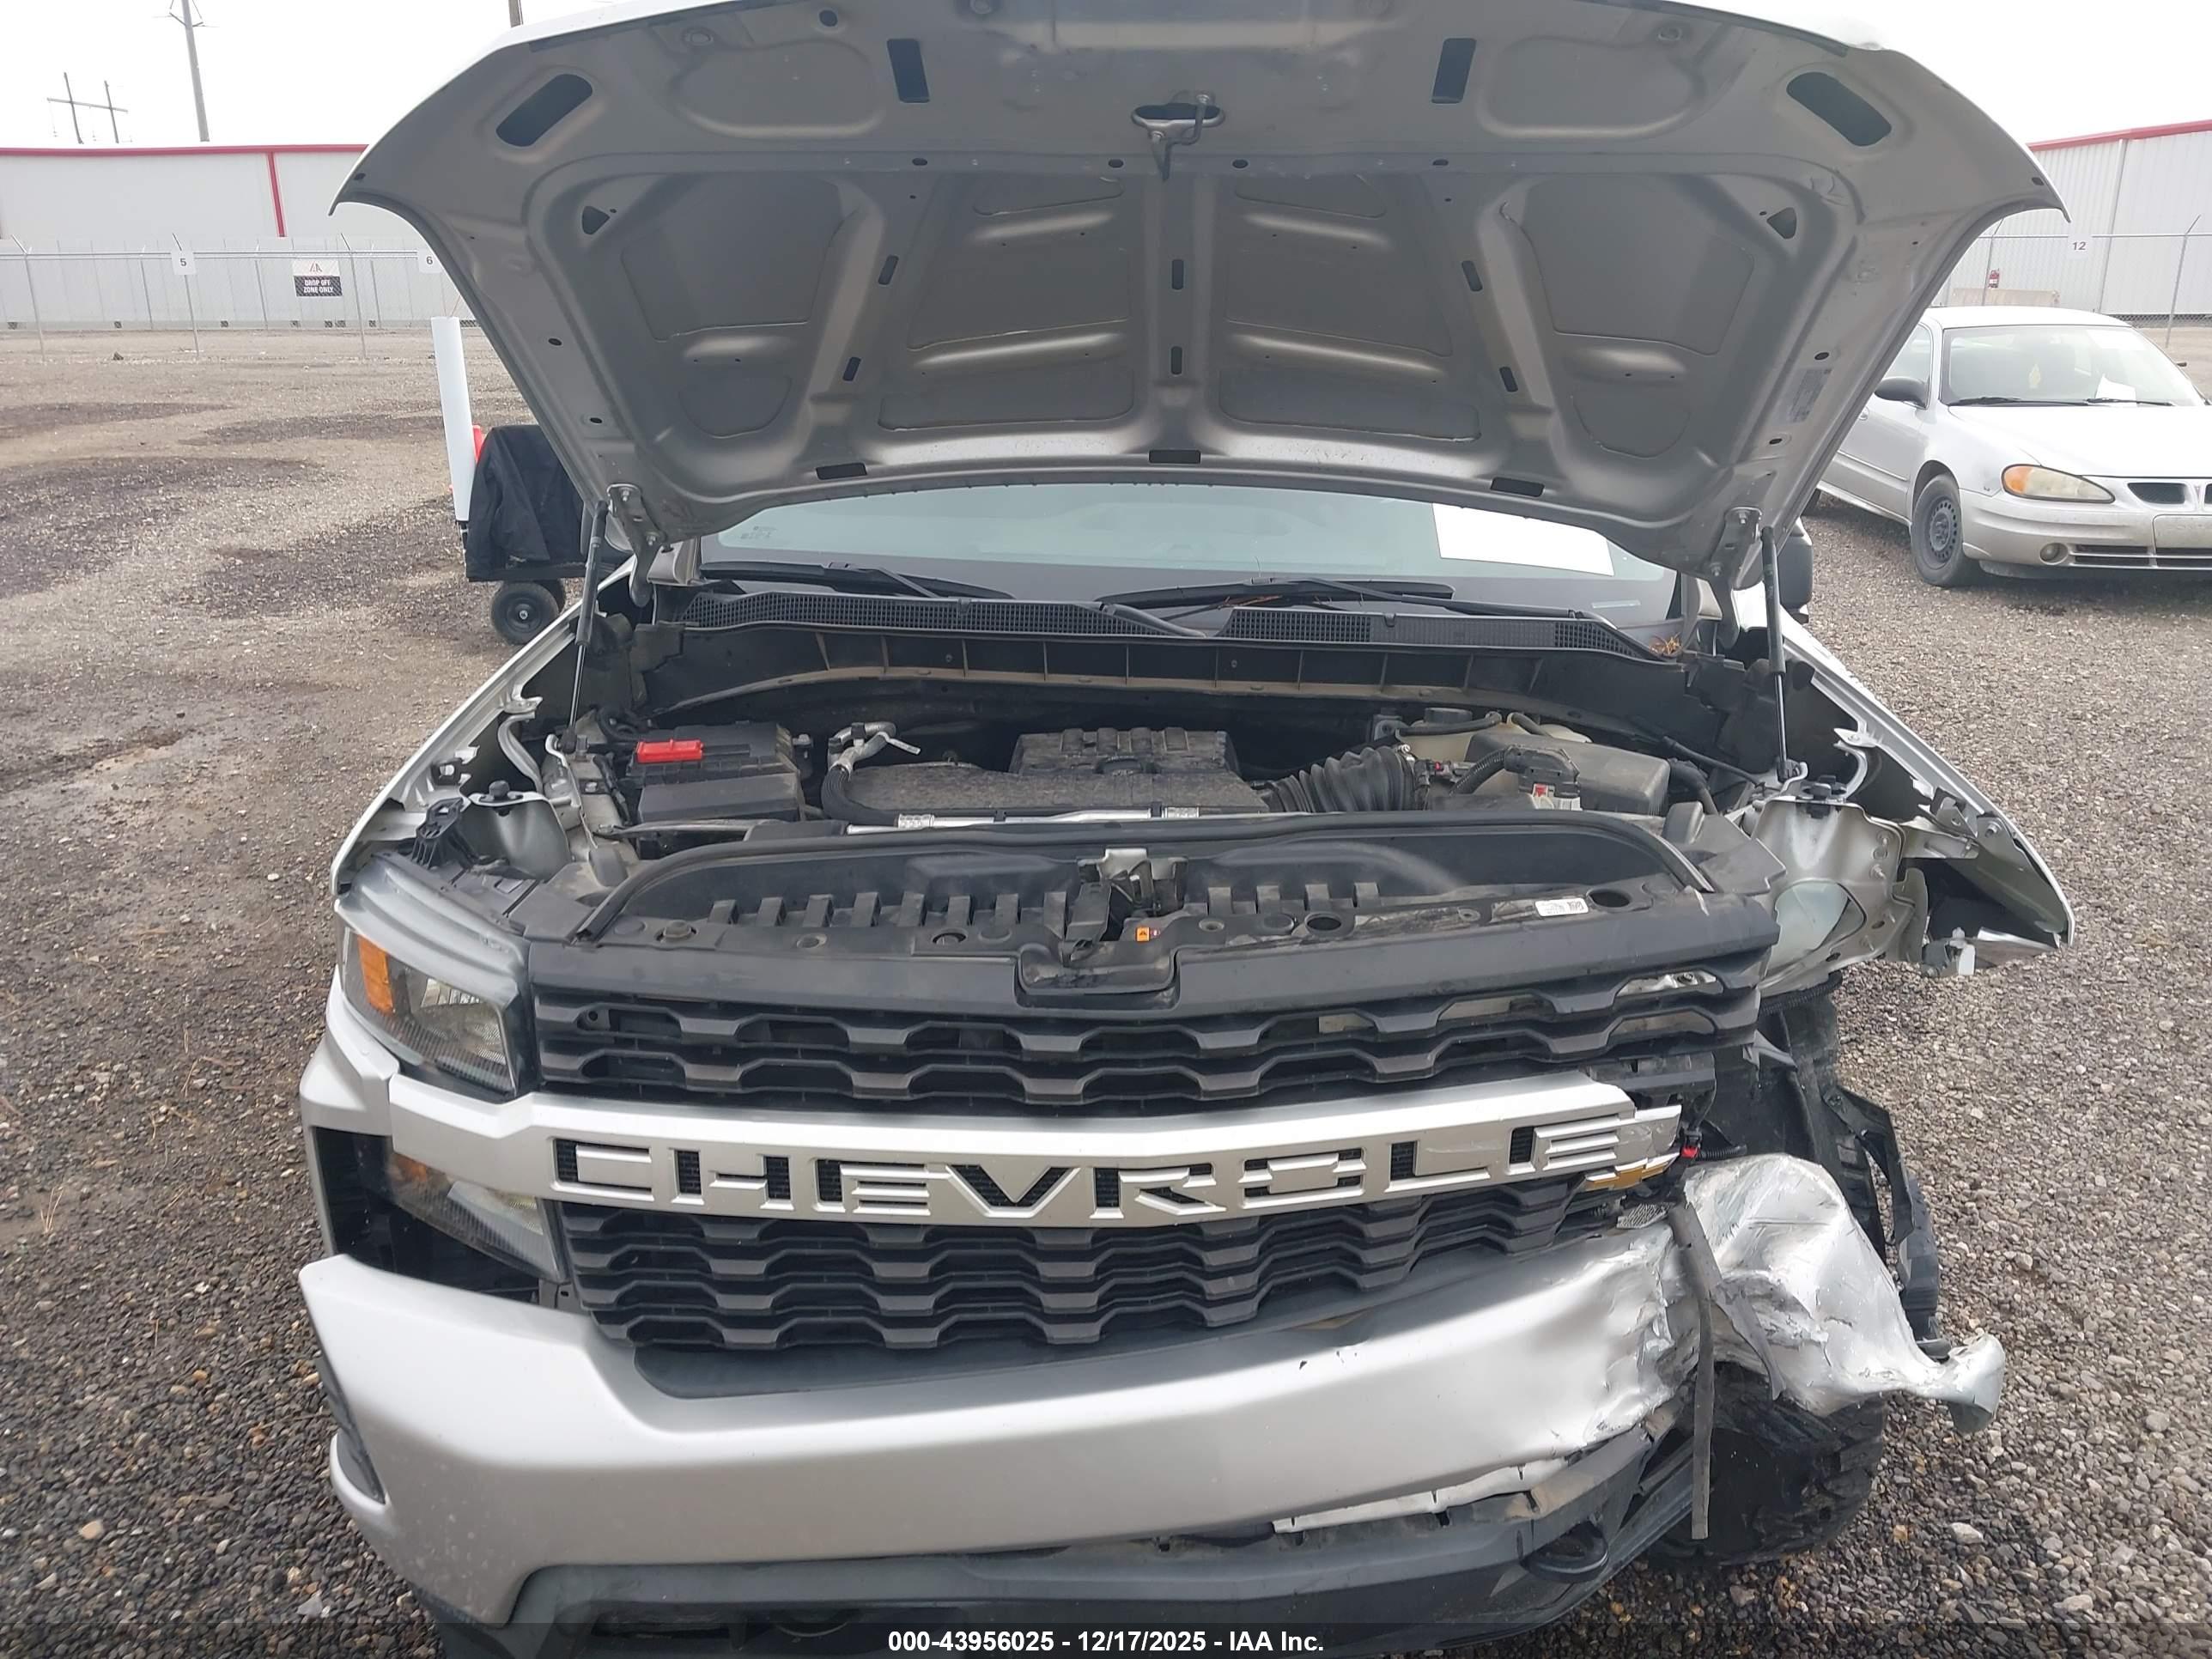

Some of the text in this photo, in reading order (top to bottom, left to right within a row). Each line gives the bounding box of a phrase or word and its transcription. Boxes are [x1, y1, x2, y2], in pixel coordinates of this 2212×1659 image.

[2072, 241, 2087, 250] 12
[179, 258, 187, 266] 5
[426, 256, 434, 264] 6
